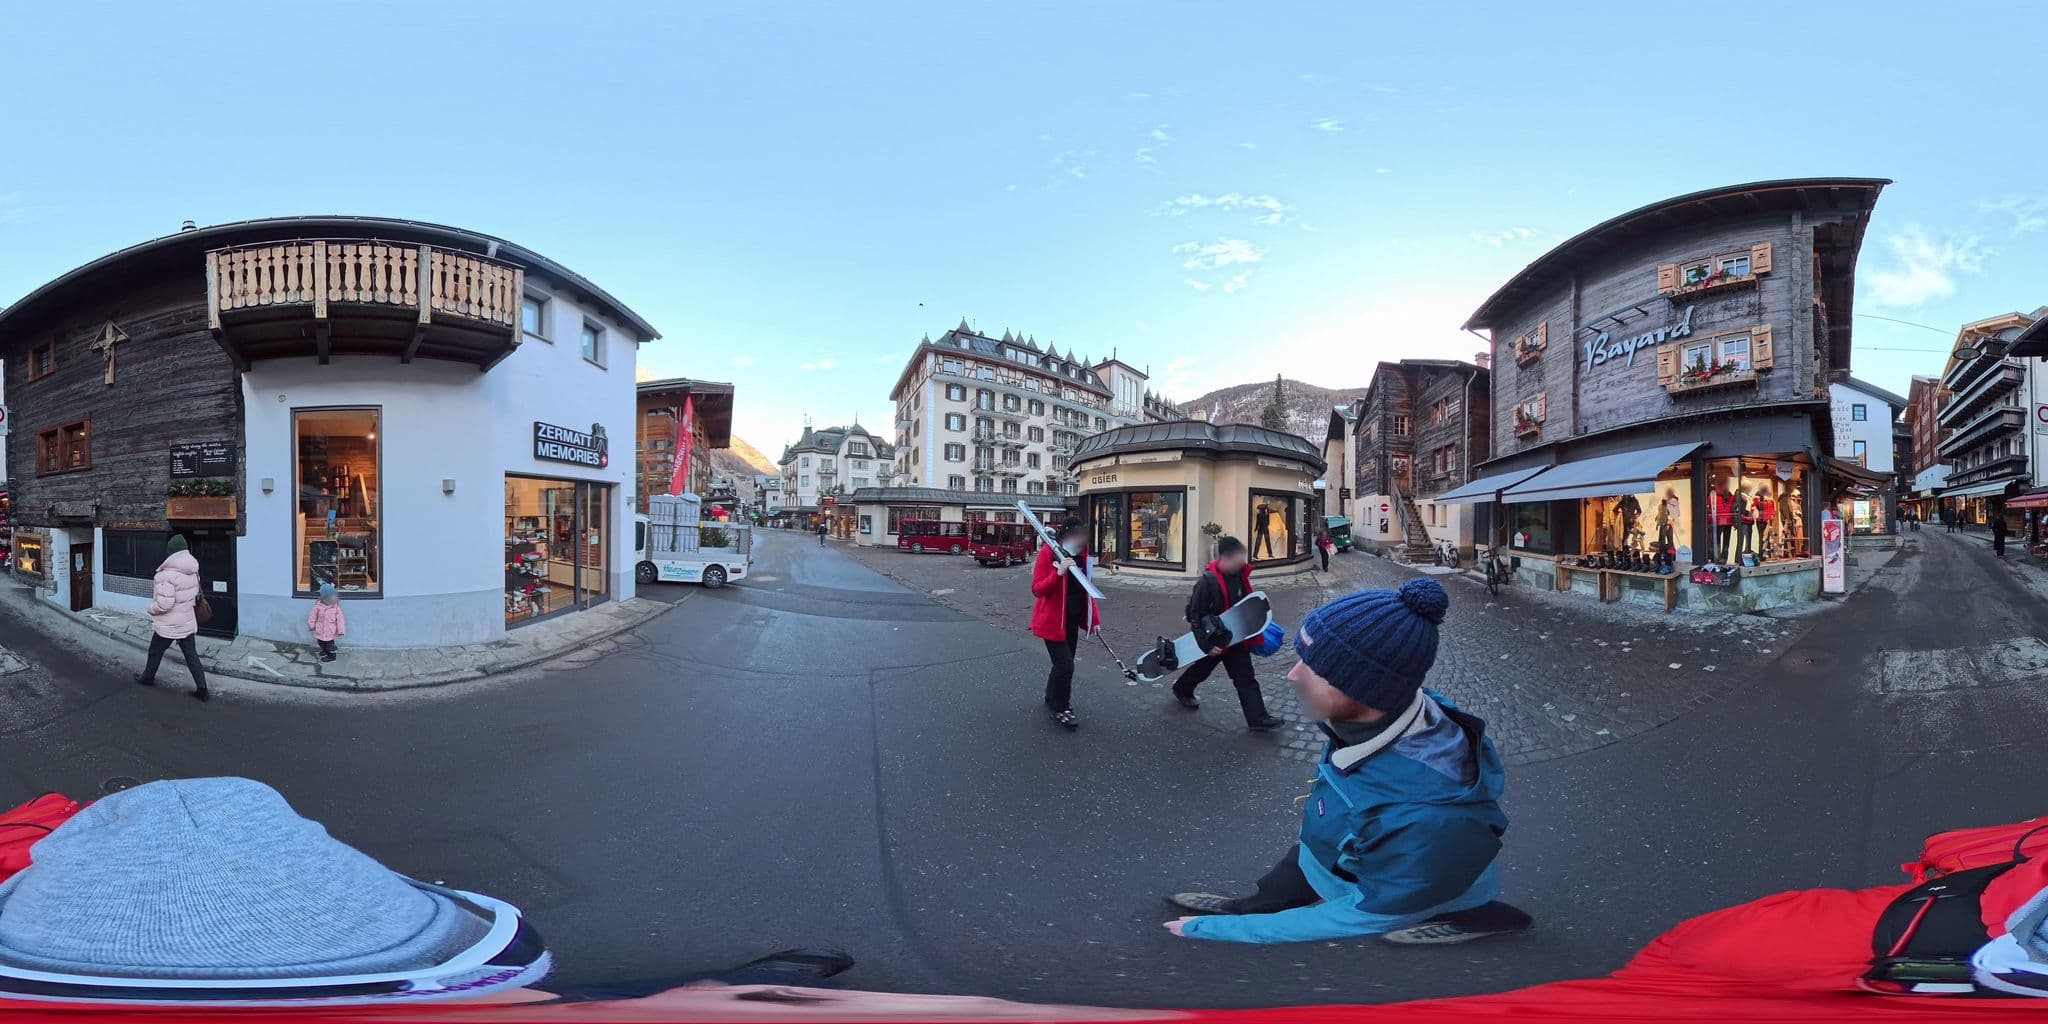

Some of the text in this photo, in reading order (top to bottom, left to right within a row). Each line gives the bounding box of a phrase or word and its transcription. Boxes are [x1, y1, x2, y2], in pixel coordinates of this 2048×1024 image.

[1584, 305, 1695, 373] Bayard
[537, 423, 592, 448] ZERMATT
[537, 442, 600, 465] MEMORIES
